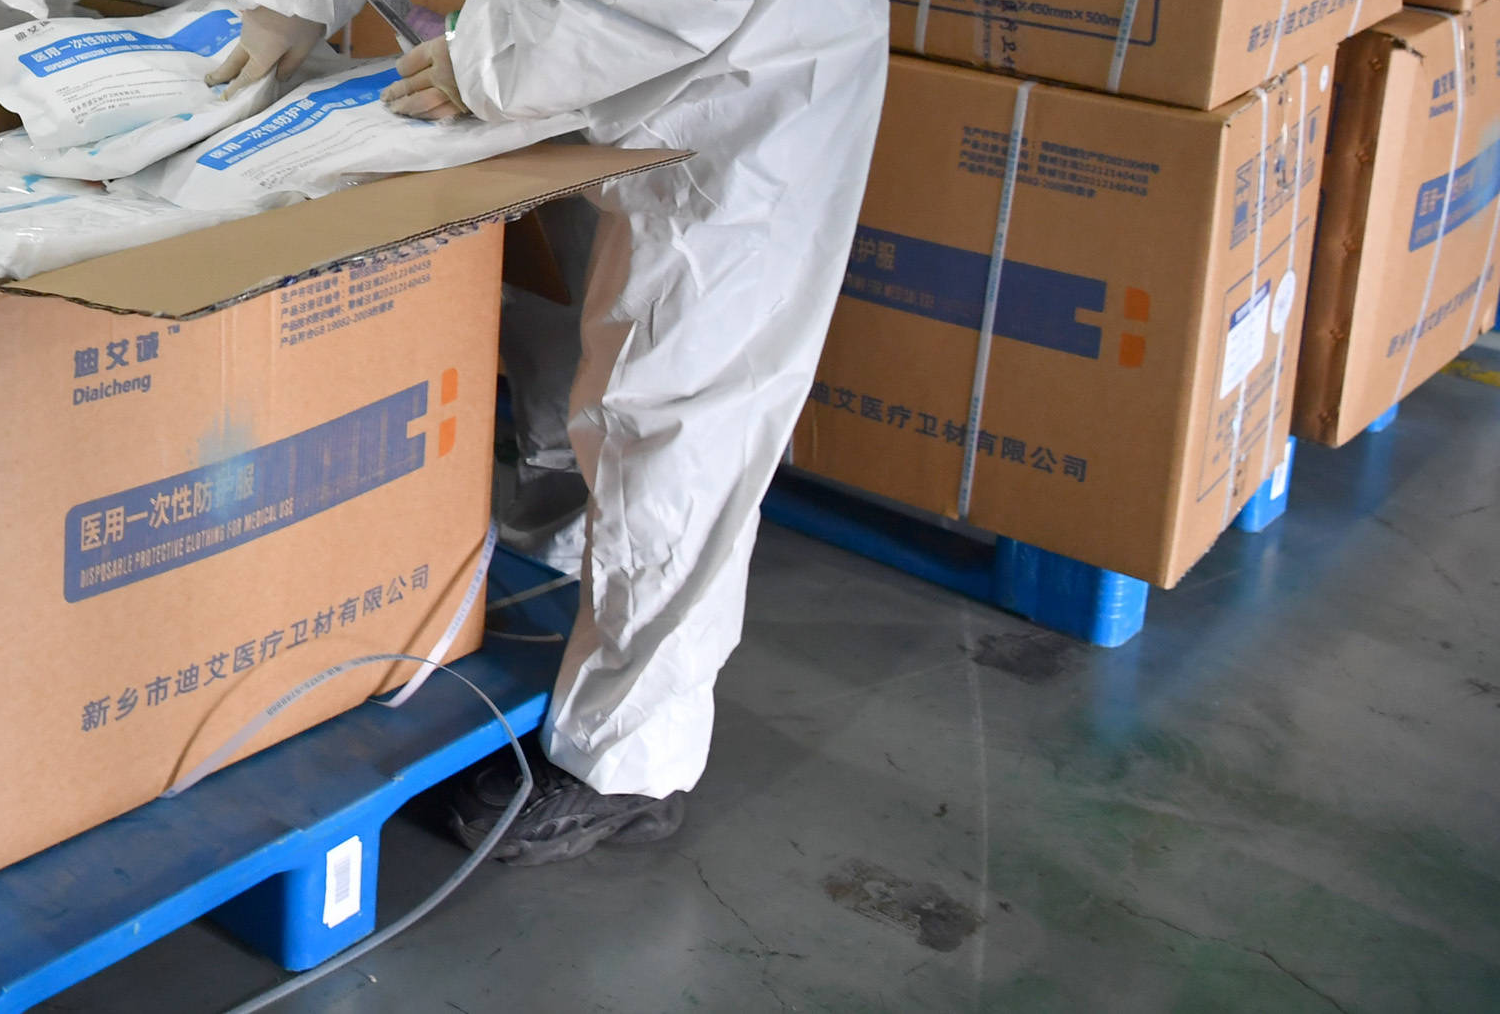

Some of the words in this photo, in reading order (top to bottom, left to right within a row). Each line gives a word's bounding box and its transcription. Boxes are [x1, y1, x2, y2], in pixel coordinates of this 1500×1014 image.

[31, 33, 138, 63] 医用一次性防护服
[209, 98, 316, 159] 医用一次性防护服
[74, 332, 159, 378] 迪艾诚
[73, 374, 152, 406] Diaicheng
[81, 462, 255, 551] 医用一次性防护服
[80, 554, 133, 588] DISPOSABLE
[135, 537, 184, 570] PROTECTIVE
[186, 524, 225, 553] CLOTHING
[227, 519, 242, 539] FOR
[244, 508, 276, 533] MEDICAL
[279, 497, 295, 518] USE
[81, 564, 430, 732] 新乡市迪艾医疗卫材有限公司
